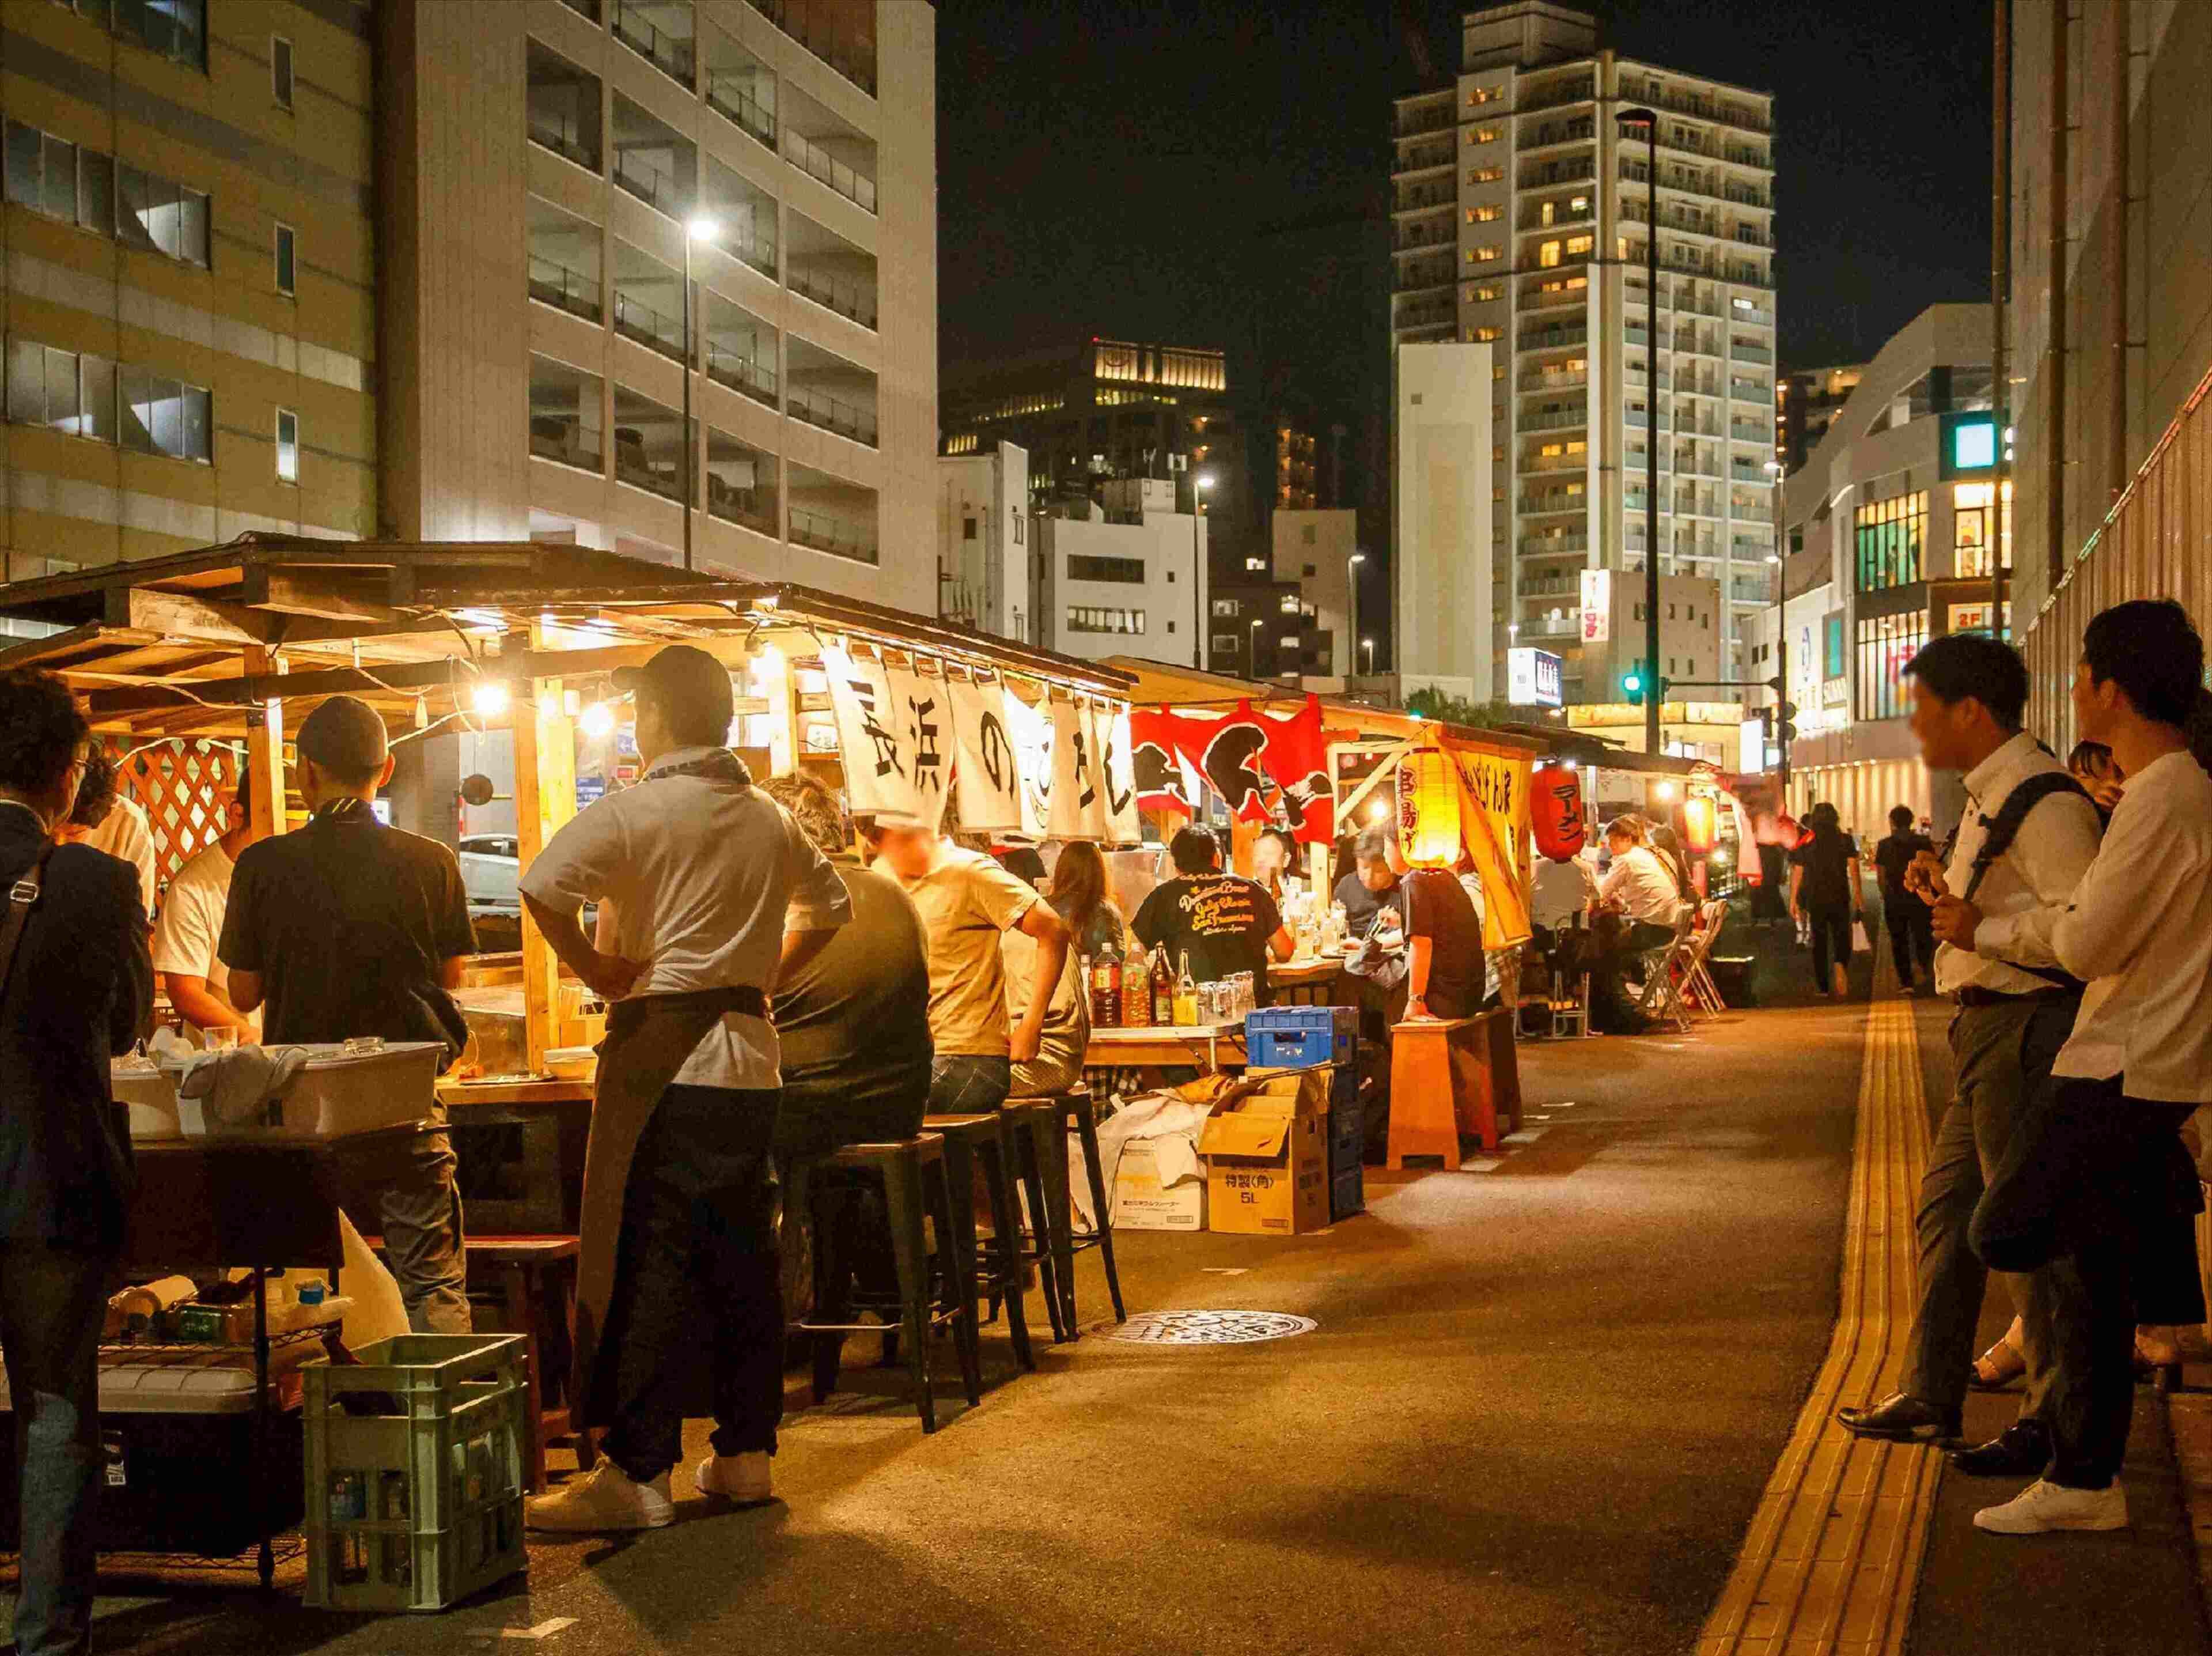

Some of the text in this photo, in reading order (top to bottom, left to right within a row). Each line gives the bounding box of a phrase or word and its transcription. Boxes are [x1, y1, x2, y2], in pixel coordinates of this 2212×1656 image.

[1552, 784, 1582, 841] ラーメン
[1241, 1192, 1260, 1204] 5L
